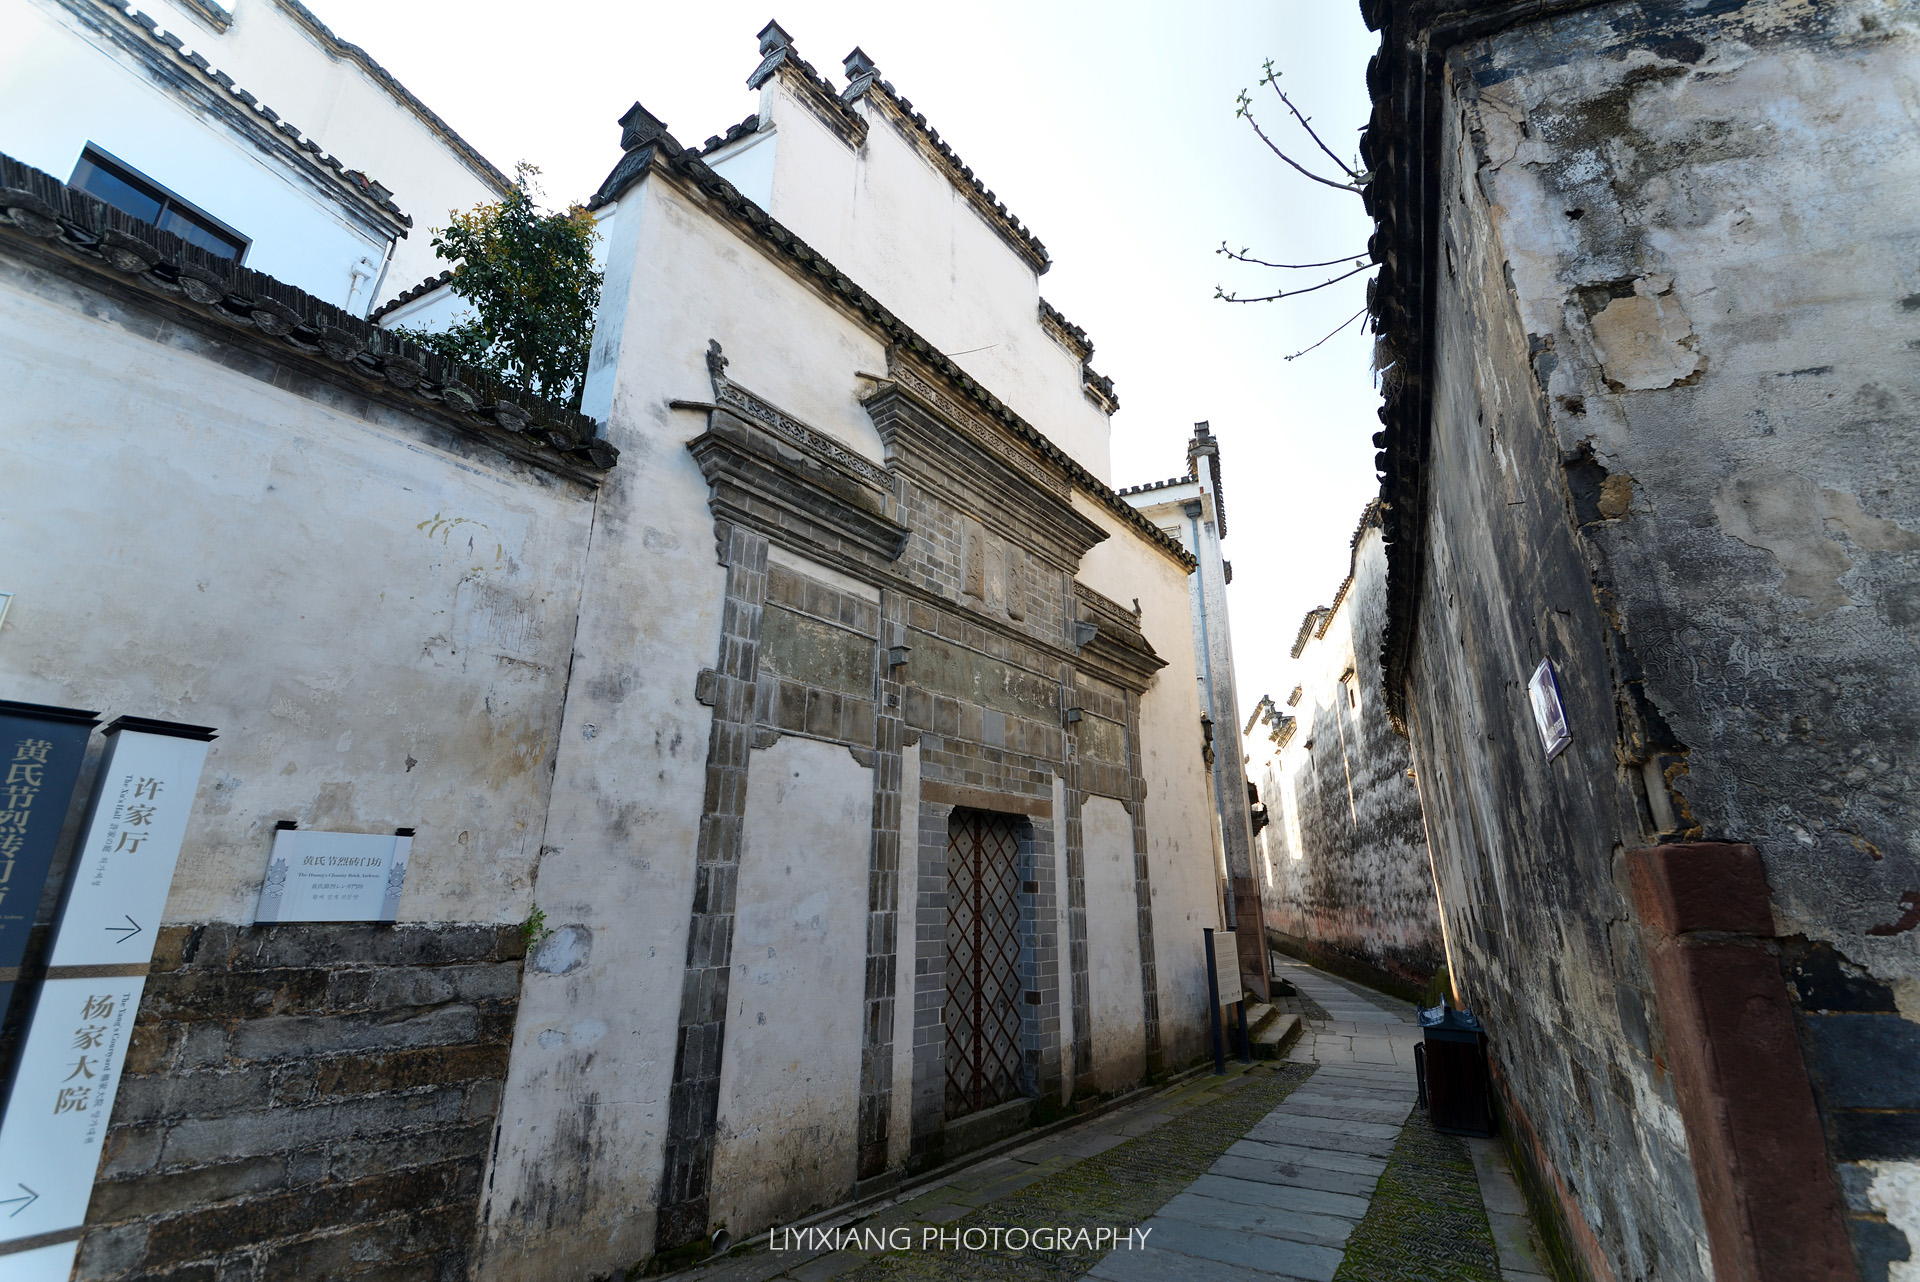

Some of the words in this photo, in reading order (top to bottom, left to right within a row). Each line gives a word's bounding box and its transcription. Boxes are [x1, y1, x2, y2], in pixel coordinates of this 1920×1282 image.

[124, 774, 134, 788] The
[113, 804, 124, 820] Hall
[113, 776, 165, 854] 许家厅
[303, 855, 383, 867] 黄氏节烈砖门坊
[121, 992, 131, 1008] The
[113, 1008, 127, 1032] Yang's
[53, 993, 115, 1115] 杨家大院
[103, 1033, 120, 1071] Courtyard
